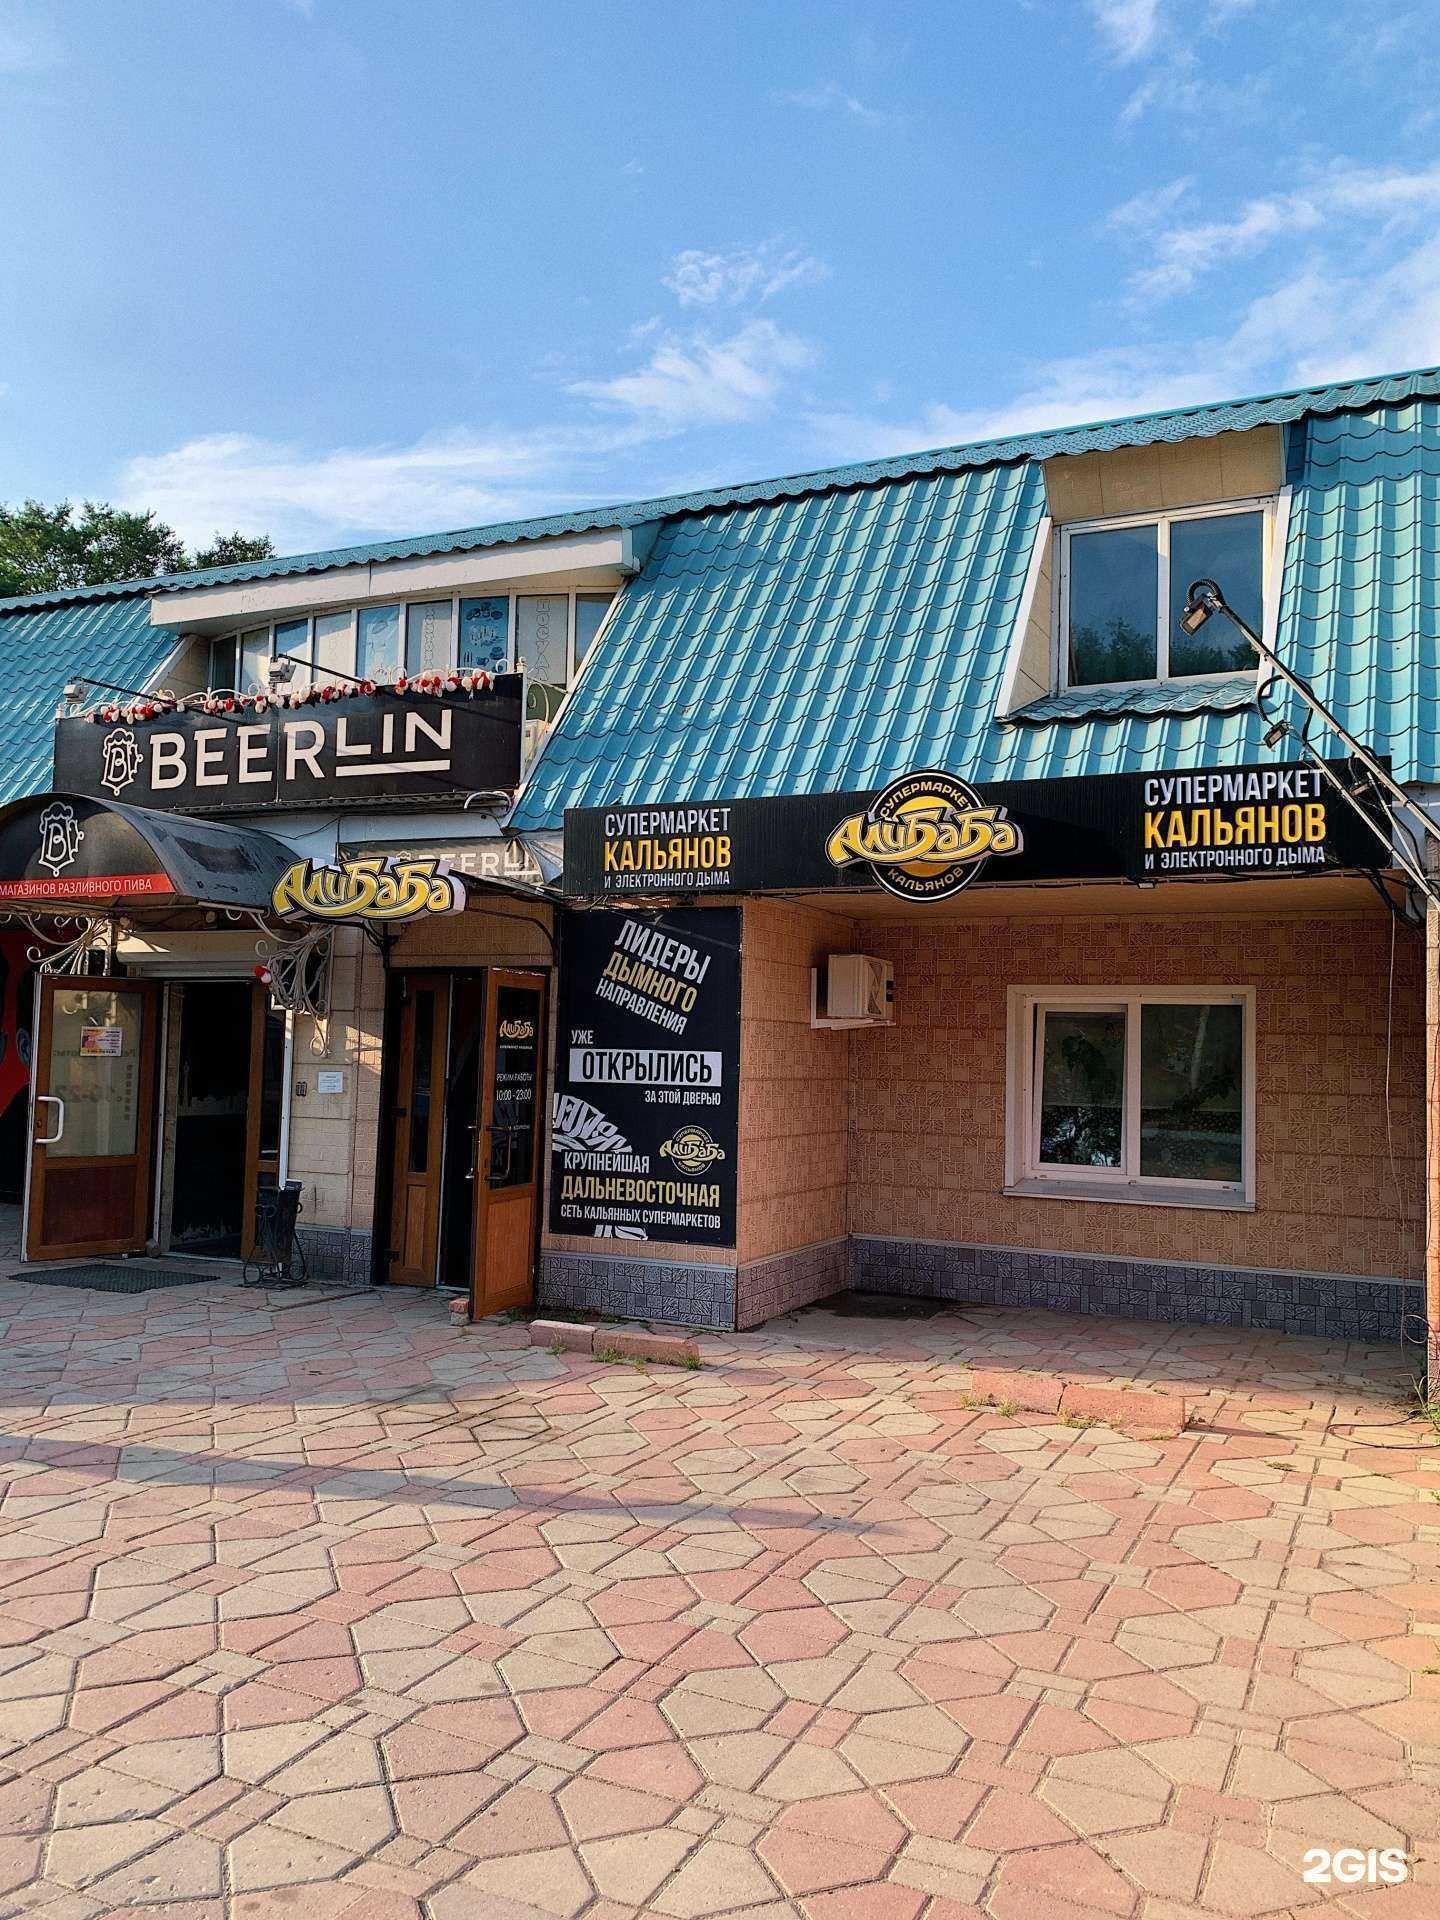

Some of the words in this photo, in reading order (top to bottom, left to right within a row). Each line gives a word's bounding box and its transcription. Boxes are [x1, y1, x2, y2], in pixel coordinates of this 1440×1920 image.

[150, 709, 452, 790] BEERLIN
[880, 781, 972, 820] СУПЕРМАРКЕТ
[1144, 769, 1324, 806] СУПЕРМАРКЕТ
[605, 808, 731, 836] СУПЕРМАРКЕТ
[1144, 803, 1327, 848] КАЛЬЯНОВ
[604, 836, 731, 871] КАЛЬЯНОВ
[1145, 853, 1154, 869] И
[1161, 848, 1272, 868] ЭЛЕКТРОННОГО
[1276, 847, 1325, 866] ДЫМА
[59, 880, 121, 893] РАЗЛИВНОГО
[124, 878, 152, 891] ПИВА
[604, 875, 611, 888] И
[615, 872, 694, 888] ЭЛЕКТРОННОГО
[696, 871, 730, 887] ДЫМА
[888, 867, 965, 891] КАЛЬЯНОВ
[614, 920, 711, 984] ЛИДЕРЫ
[602, 951, 697, 1012] ДЫМНОГО
[596, 978, 688, 1035] НАПРАВЛЕНИЯ
[571, 1030, 594, 1044] УЖЕ
[582, 1051, 712, 1083] ОТКРЫЛИСЬ
[645, 1090, 656, 1103] ЗА
[658, 1088, 681, 1104] ЭТОЙ
[683, 1091, 721, 1106] ДВЕРЬЮ
[564, 1150, 649, 1174] КРУПНЕЙШАЯ
[561, 1176, 720, 1208] ДАЛЬНЕВОСТОЧНАЯ
[561, 1204, 582, 1218] СЕТЬ
[584, 1206, 640, 1223] КАЛЬЯННЫХ
[642, 1209, 721, 1229] СУПЕРМАРКЕТОВ
